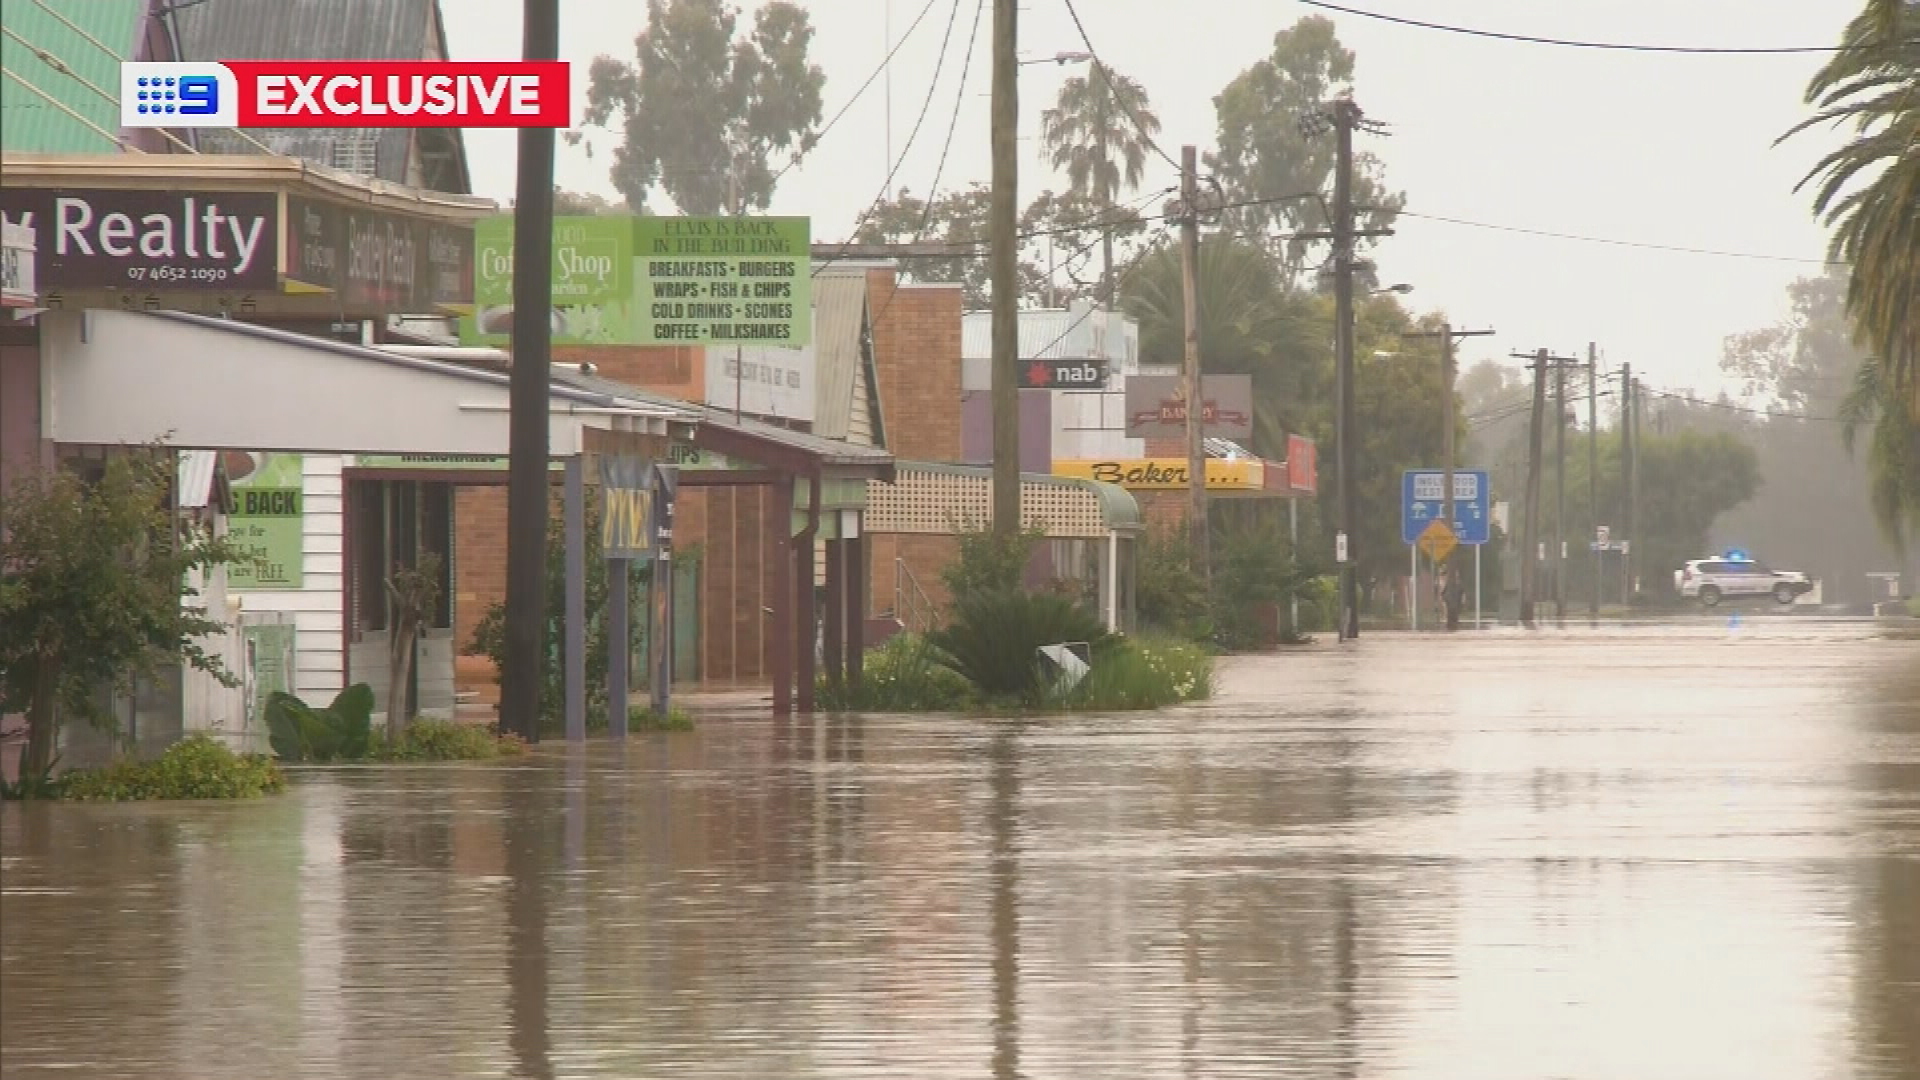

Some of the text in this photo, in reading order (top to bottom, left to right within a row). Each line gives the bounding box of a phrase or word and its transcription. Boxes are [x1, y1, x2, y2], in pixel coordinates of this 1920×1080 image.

[56, 198, 265, 274] Realty
[665, 221, 779, 235] ELVIS IS BACK
[653, 238, 791, 253] IN THE BUILDING
[557, 246, 611, 281] Shop
[649, 261, 796, 277] BREAKFASTS BURGERS
[128, 267, 227, 281] 07 4652 1090
[653, 281, 791, 297] WRAPS FISH & CHIPS
[651, 303, 793, 318] COLD DRINKS SCONES
[654, 323, 791, 339] COFFEE MILKSHAKES
[1056, 364, 1097, 382] nab
[245, 491, 296, 514] BACK
